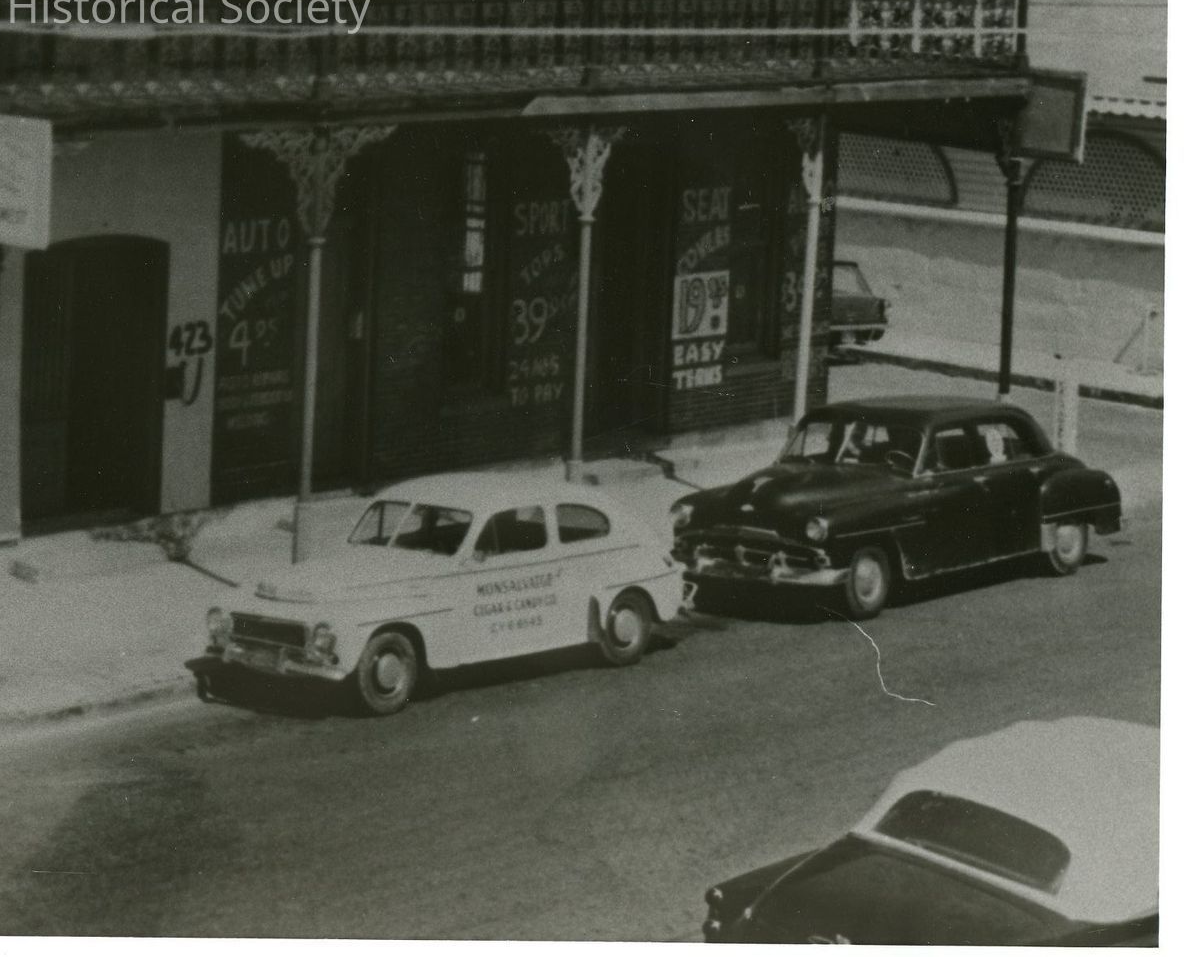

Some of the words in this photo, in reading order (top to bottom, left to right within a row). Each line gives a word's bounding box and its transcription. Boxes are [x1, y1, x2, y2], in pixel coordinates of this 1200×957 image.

[513, 198, 569, 236] SPORT
[682, 186, 732, 222] SEAT
[223, 216, 291, 254] AUTO
[519, 243, 565, 286] TOPS
[219, 265, 268, 321] TUNE
[269, 253, 294, 280] UP
[169, 320, 212, 356] 423
[673, 339, 727, 366] EASY
[509, 385, 530, 407] TO
[534, 381, 565, 404] PAY
